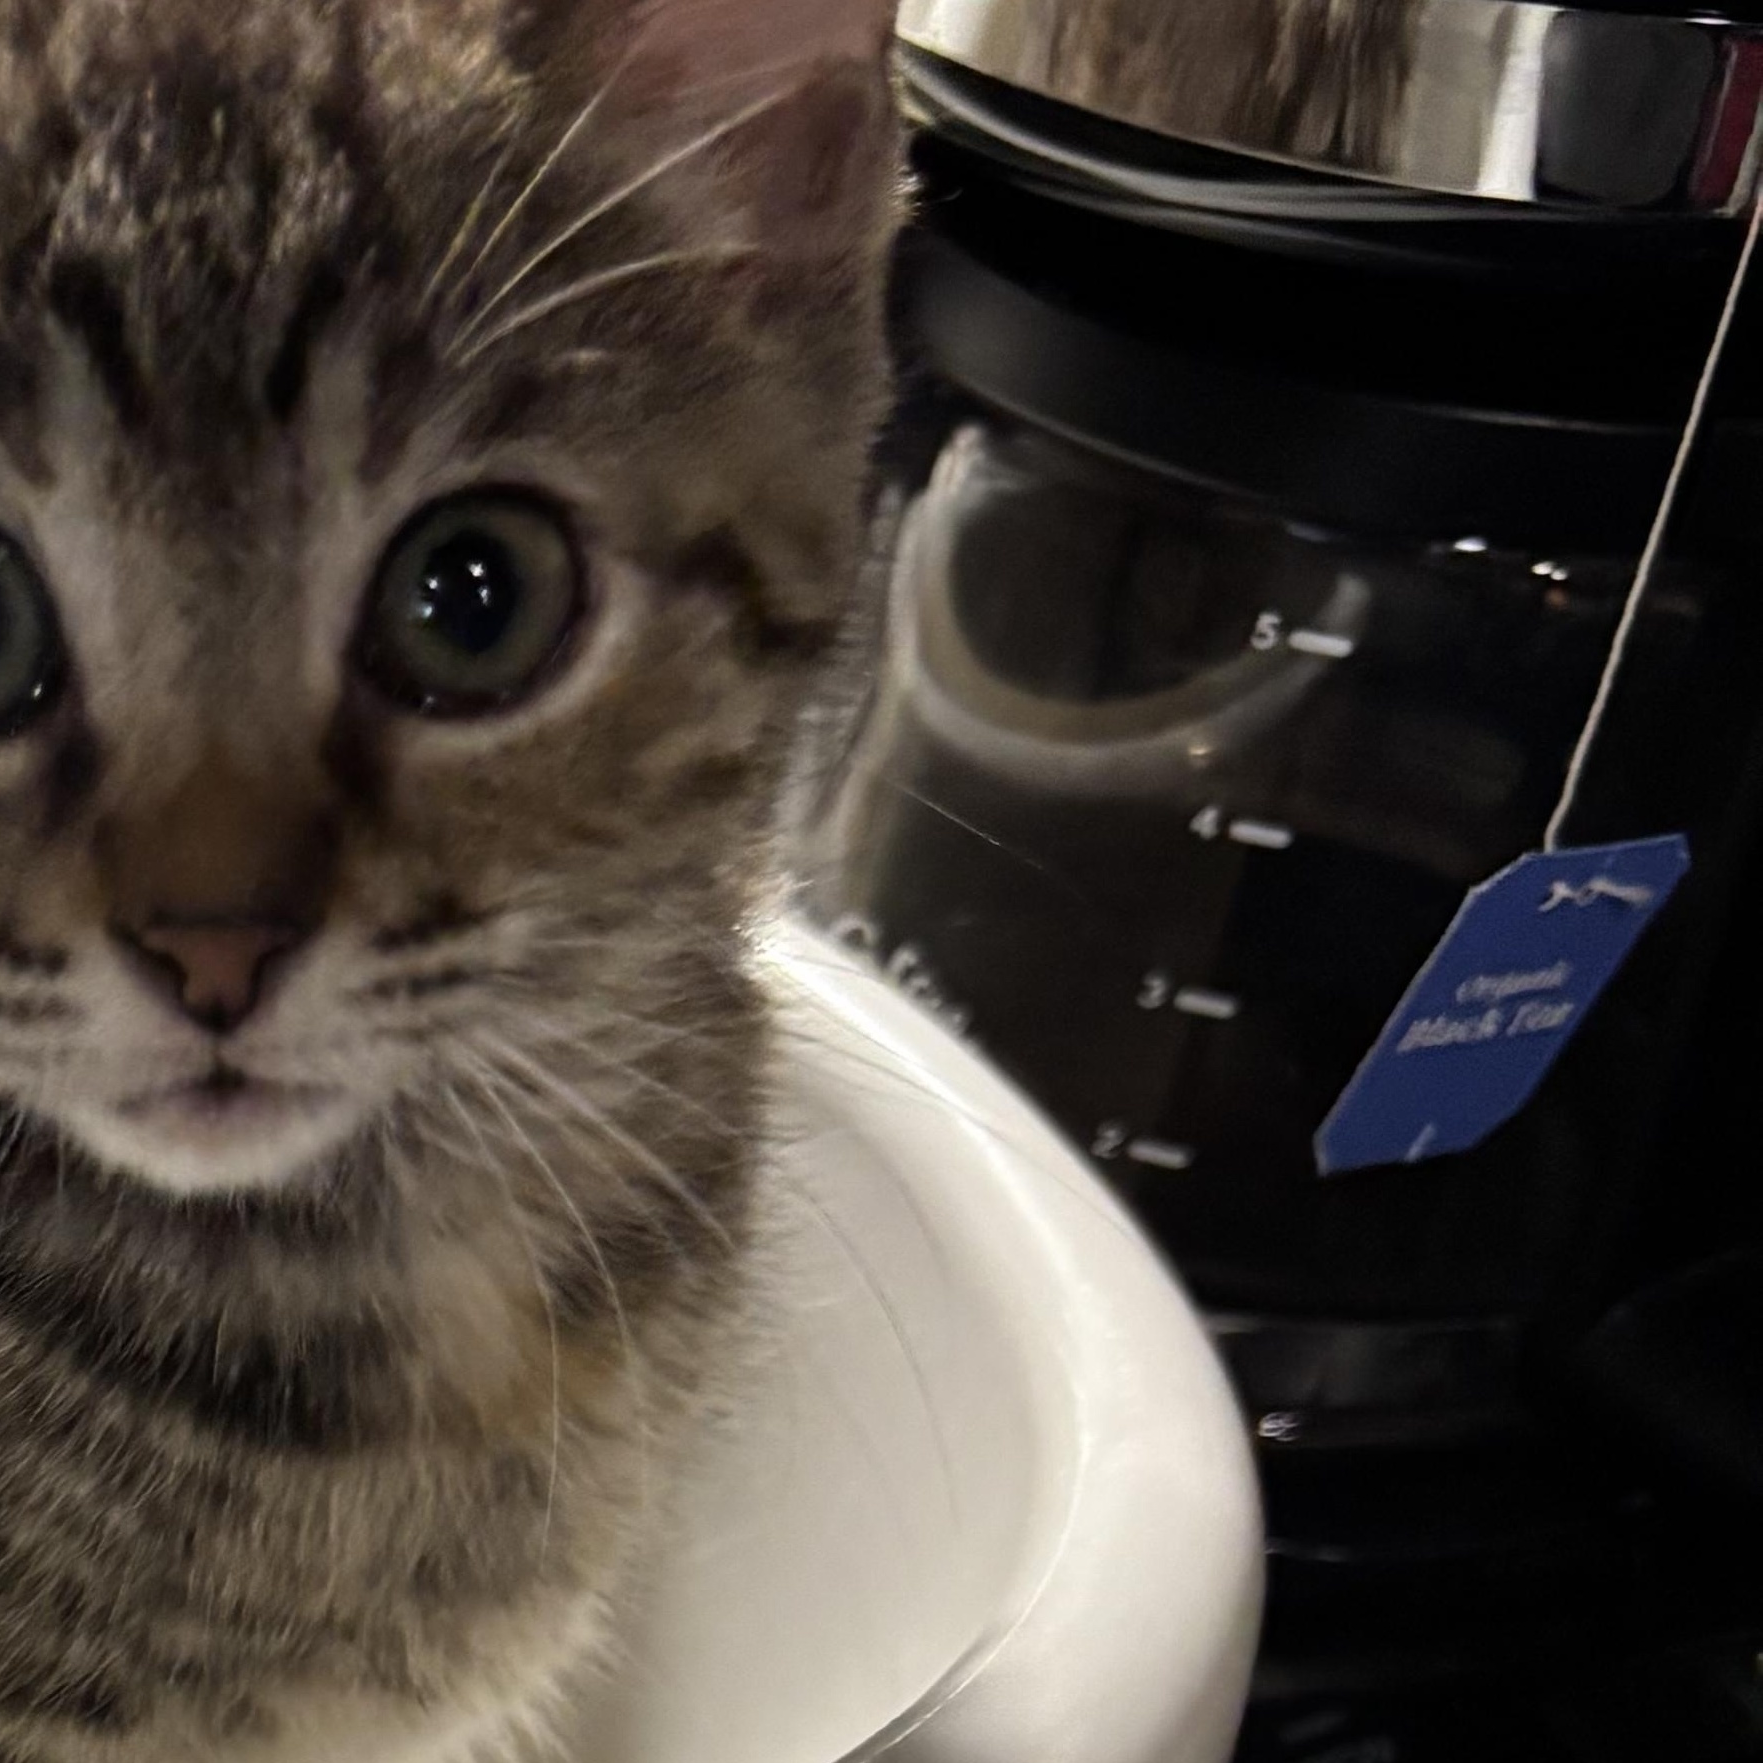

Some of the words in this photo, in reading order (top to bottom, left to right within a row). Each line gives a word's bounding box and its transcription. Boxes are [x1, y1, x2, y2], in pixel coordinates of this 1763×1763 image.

[1250, 611, 1282, 650] 5
[1189, 804, 1222, 841] 4
[1137, 971, 1168, 1009] 3
[1091, 1122, 1125, 1160] 2
